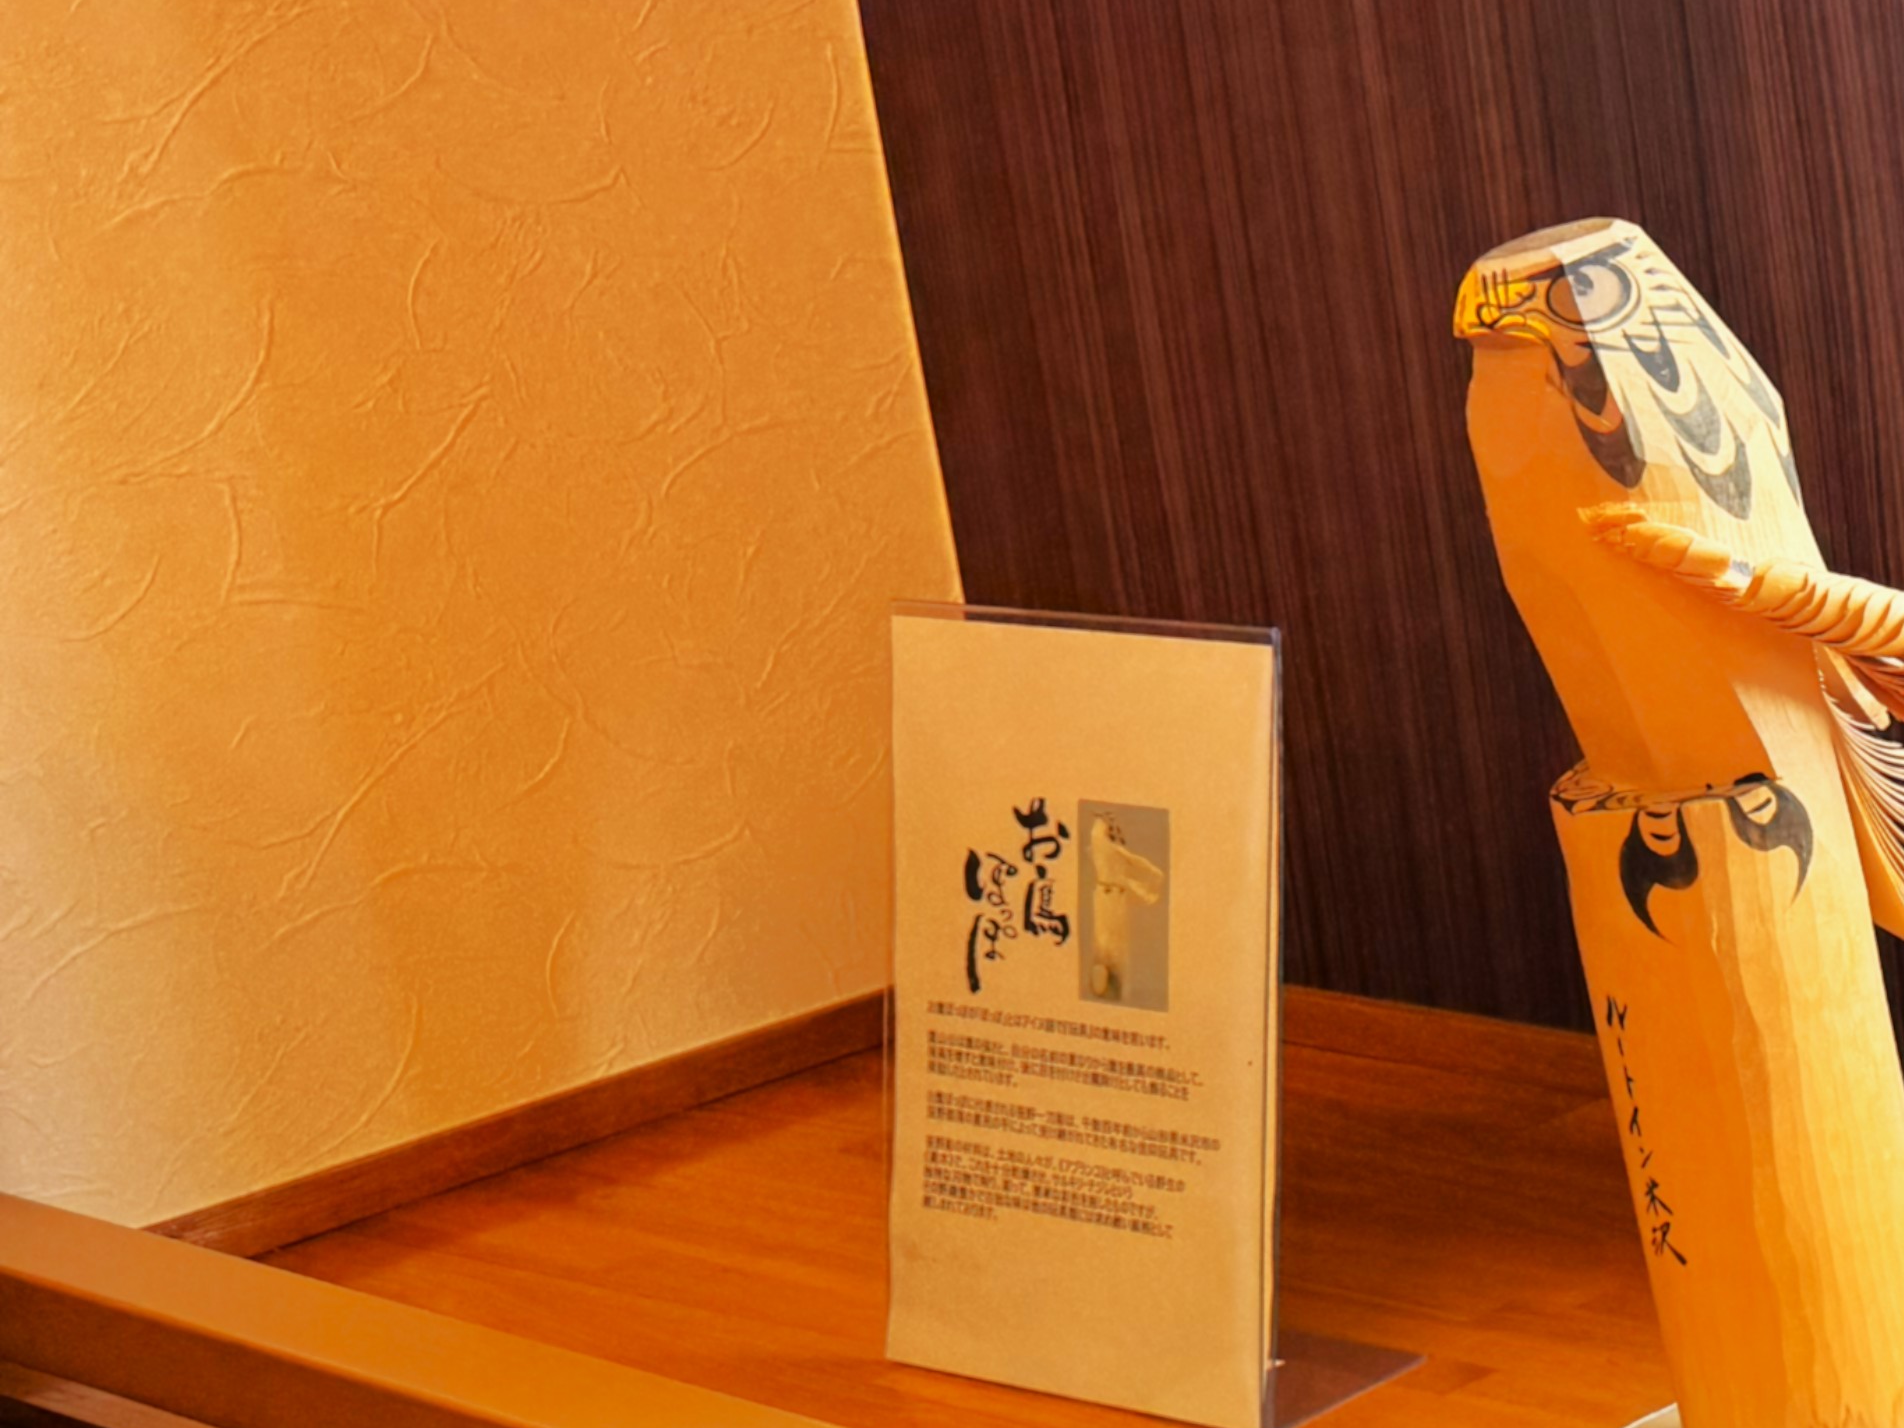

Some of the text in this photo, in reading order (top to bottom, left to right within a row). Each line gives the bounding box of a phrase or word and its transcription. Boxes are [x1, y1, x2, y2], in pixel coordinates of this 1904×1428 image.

[1605, 994, 1688, 1266] ルートイン米沢
